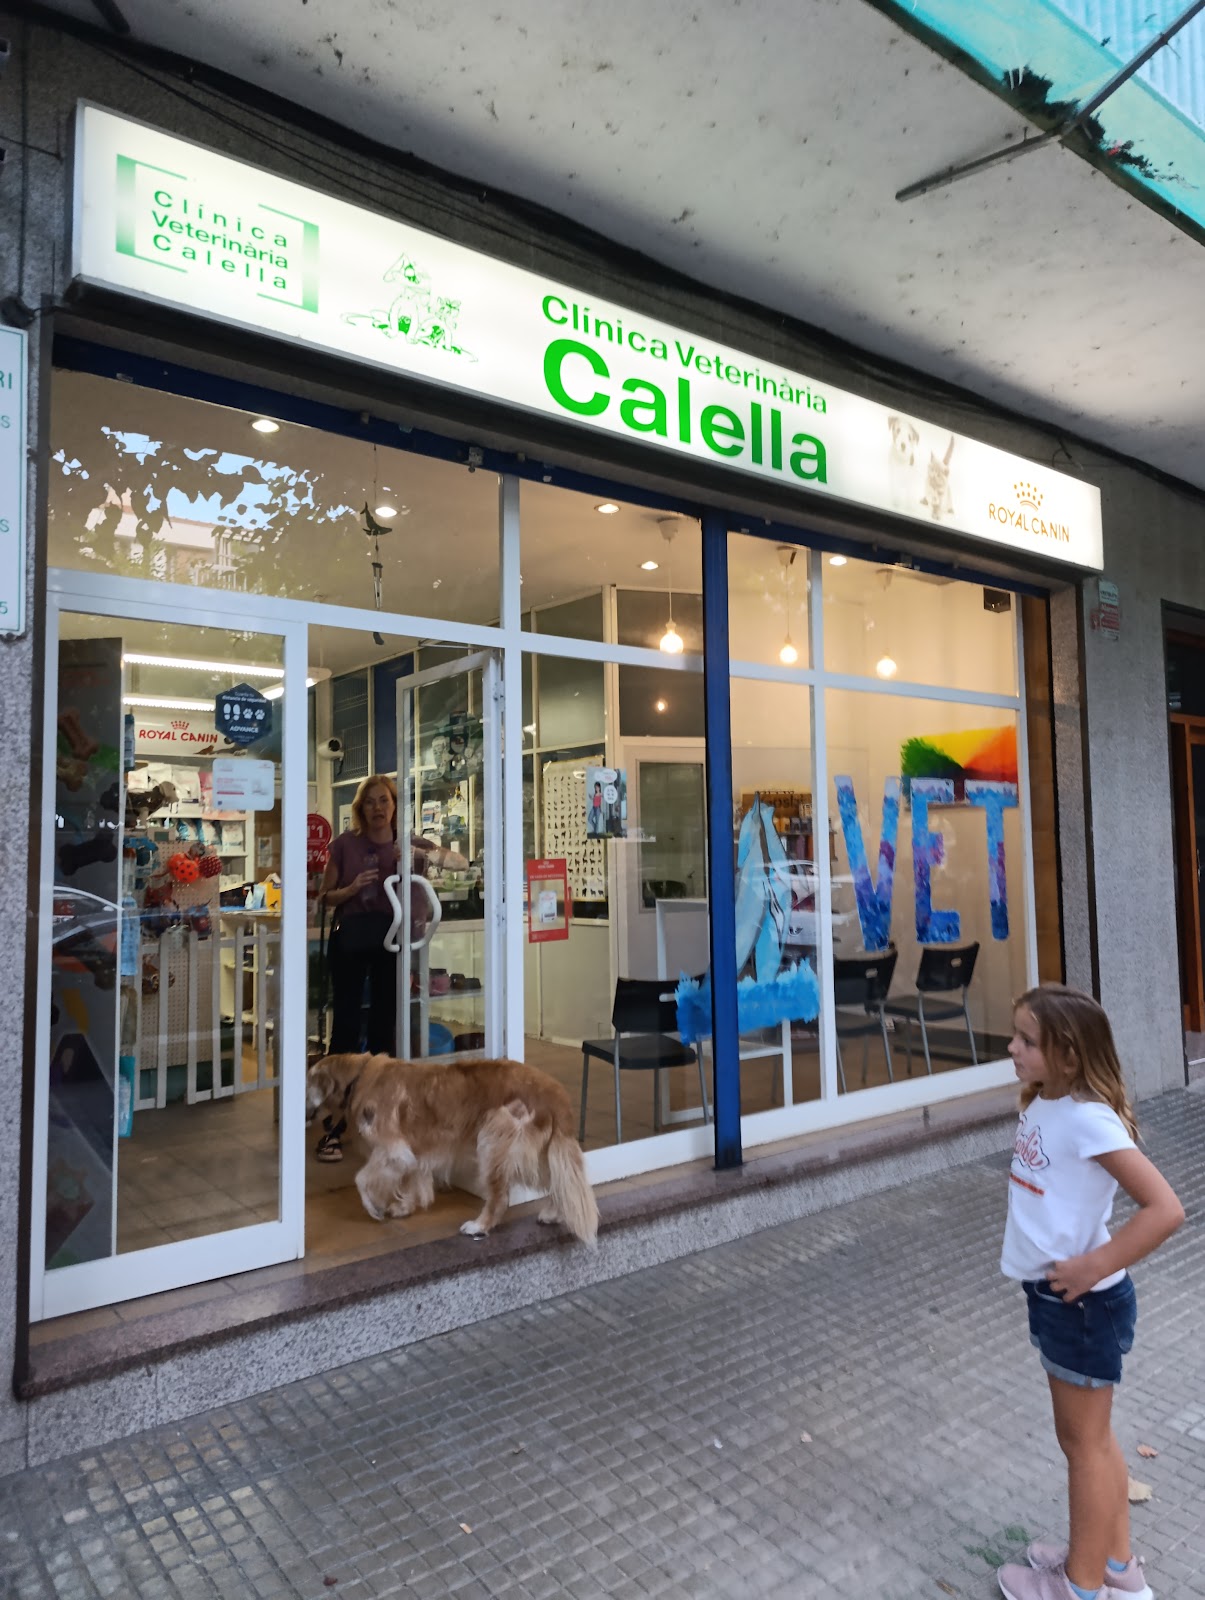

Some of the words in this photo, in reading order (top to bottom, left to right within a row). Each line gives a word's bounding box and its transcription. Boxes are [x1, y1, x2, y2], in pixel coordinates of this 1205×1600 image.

[152, 210, 288, 269] Veterinària
[154, 190, 287, 248] Clínica
[153, 234, 287, 289] Calella
[542, 295, 668, 361] Clínica
[675, 340, 827, 415] Veterinària
[543, 338, 828, 484] Calella
[989, 503, 1029, 532] ROYAL
[1032, 517, 1070, 543] CANIN
[138, 729, 177, 741] ROYAL
[180, 732, 218, 744] CANIN
[229, 725, 259, 733] ADVANCE
[834, 774, 1018, 951] VET
